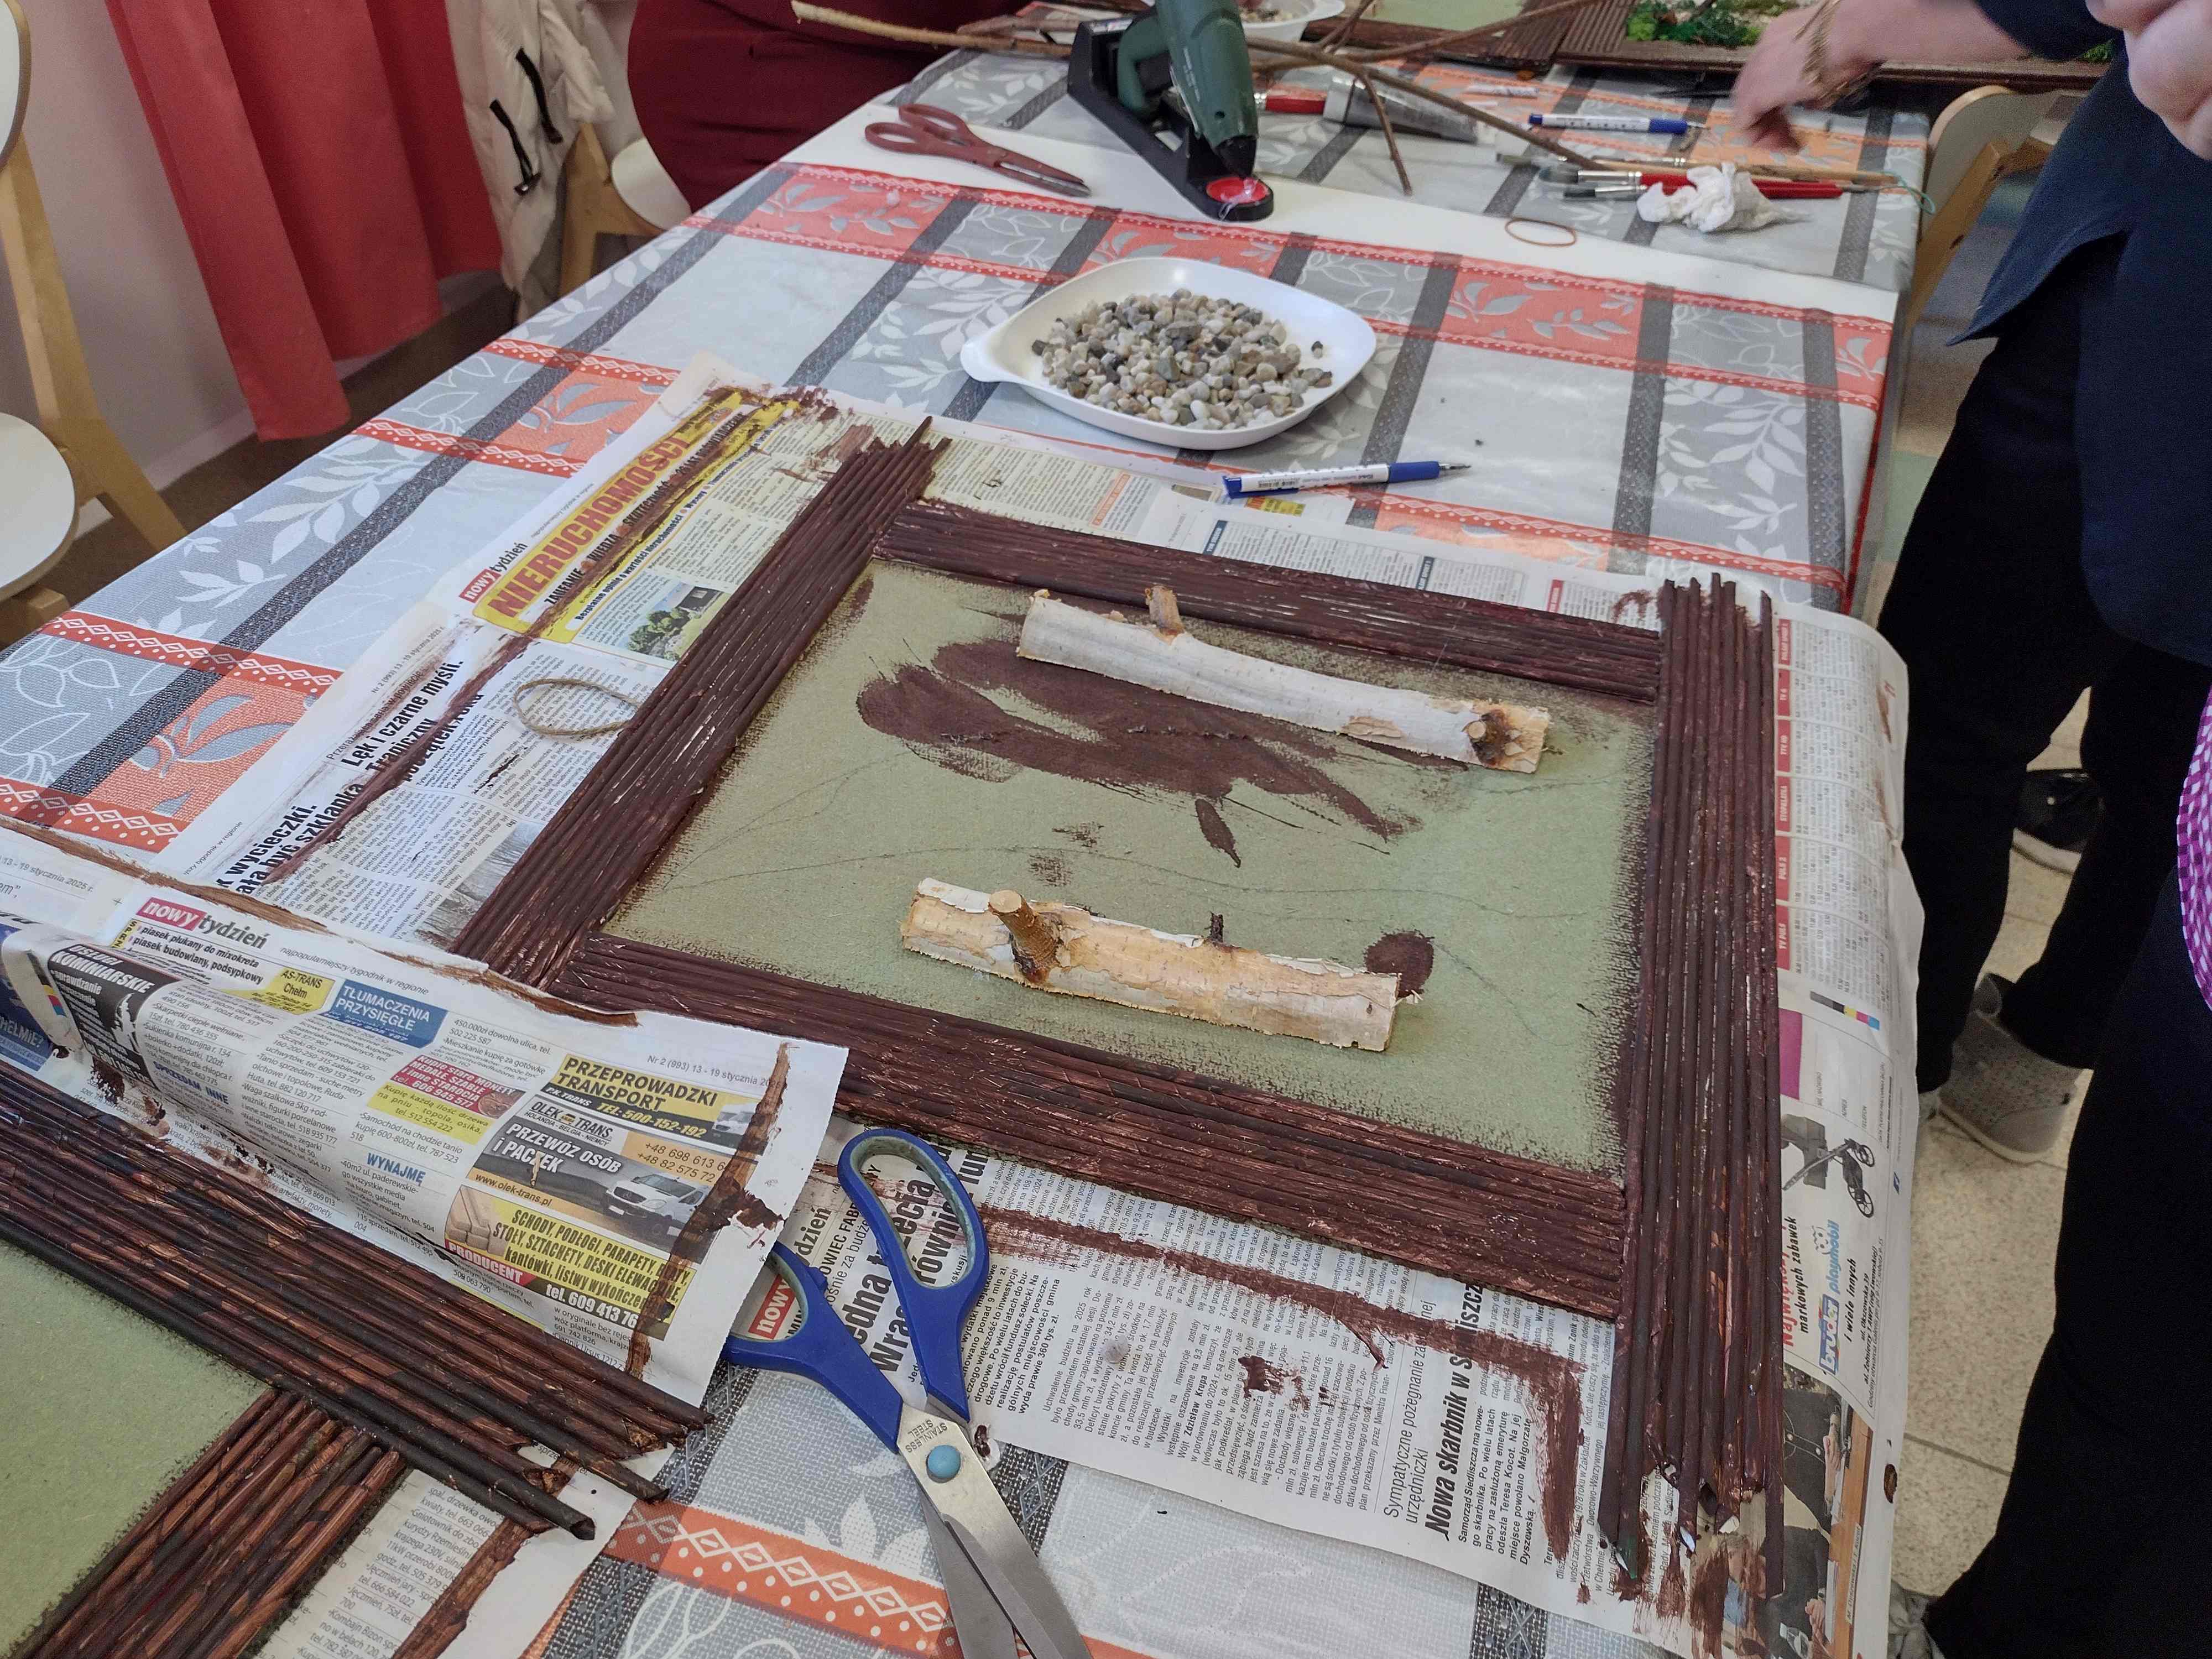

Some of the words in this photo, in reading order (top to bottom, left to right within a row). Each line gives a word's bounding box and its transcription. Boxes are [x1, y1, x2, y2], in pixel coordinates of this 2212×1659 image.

[488, 435, 692, 618] NIERUCHOMOŚCI
[465, 575, 497, 601] nowy
[491, 542, 528, 574] tydzień
[544, 568, 587, 604] ZAUFANIE
[586, 534, 622, 562] WIEDZA
[575, 592, 607, 620] Bezpłatne
[602, 575, 622, 593] opinie
[623, 551, 649, 575] wartości
[645, 514, 685, 551] nieruchomości
[340, 743, 374, 768] Lęk
[368, 735, 387, 744] i
[379, 695, 429, 738] czarne
[420, 660, 464, 696] myśli.
[226, 804, 317, 875] wycieczki.
[260, 842, 301, 870] być
[297, 782, 365, 843] szklanka
[3, 857, 13, 865] 13
[19, 862, 29, 870] 19
[29, 866, 65, 883] stycznia
[65, 877, 87, 890] 2025
[145, 899, 201, 928] nowy
[200, 914, 269, 951] tydzień
[133, 935, 163, 953] piasek
[162, 944, 212, 969] budowlany,
[210, 959, 264, 987] podsypkowy
[140, 925, 171, 943] piasek
[170, 934, 204, 953] płukany
[204, 945, 216, 955] do
[215, 948, 259, 969] mixokreta
[51, 953, 155, 993] KOMINIARSKIE
[280, 967, 323, 990] AS-TRANS
[283, 982, 309, 999] Chełm
[349, 964, 387, 985] tygodnik
[394, 978, 430, 998] regionie
[335, 997, 416, 1032] PRZYSIĘGŁE
[341, 985, 431, 1024] TŁUMACZENIA
[406, 1067, 432, 1083] inne
[429, 1076, 482, 1103] STAROCIA
[409, 1060, 449, 1081] MEDALE
[448, 1074, 487, 1095] SZABLE
[473, 1075, 516, 1097] MONETY
[564, 1055, 718, 1109] PRZEPROWADZKI
[647, 1053, 659, 1064] Nr
[659, 1057, 666, 1066] 2
[666, 1058, 691, 1072] (993)
[691, 1064, 702, 1074] 13
[709, 1068, 720, 1078] 19
[720, 1068, 758, 1088] stycznia
[383, 1084, 409, 1099] Kupię
[408, 1093, 435, 1109] każdą
[436, 1103, 458, 1116] ilość
[458, 1112, 489, 1127] drzewa
[393, 1073, 410, 1084] tel.
[411, 1079, 434, 1094] 606
[433, 1087, 455, 1102] 945
[453, 1095, 474, 1109] 577
[556, 1072, 666, 1114] TRANSPORT
[395, 1108, 408, 1117] tel.
[408, 1112, 421, 1121] 512
[421, 1116, 436, 1126] 554
[435, 1121, 453, 1133] 222
[524, 1110, 556, 1126] HOLANDIA
[557, 1123, 582, 1136] BELGIA
[583, 1134, 610, 1147] NIEMCY
[530, 1099, 563, 1119] OLEK
[574, 1117, 612, 1139] TRANS
[620, 1108, 707, 1140] 500-152-192
[492, 1136, 504, 1153] i
[500, 1140, 565, 1175] PACZEK
[504, 1121, 582, 1159] PRZEWÓZ
[578, 1147, 623, 1175] OSÓB
[635, 1150, 658, 1165] +48
[657, 1156, 675, 1171] 82
[675, 1162, 699, 1178] 575
[644, 1140, 666, 1155] +48
[666, 1146, 690, 1162] 698
[691, 1154, 717, 1170] 613
[364, 1152, 427, 1186] WYNAJMĘ
[473, 1172, 554, 1208] www.olek-trans.pl
[491, 1220, 526, 1248] STOŁY,
[523, 1232, 587, 1268] SZTACHETY,
[582, 1254, 616, 1278] DESKI
[510, 1208, 557, 1237] SCHODY,
[552, 1222, 604, 1255] PODŁOGI,
[599, 1240, 659, 1277] PARAPETY,
[1785, 1217, 1801, 1264] zabawek
[1828, 1219, 1840, 1294] playmobil
[448, 1243, 523, 1283] PRODUCENT
[544, 1281, 570, 1302] tel.
[567, 1291, 598, 1313] 609
[596, 1301, 622, 1322] 413
[502, 1246, 557, 1281] kantówki,
[553, 1264, 591, 1292] listwy
[1848, 1258, 1858, 1297] innych
[1050, 1313, 1060, 1324] zł.
[1793, 1267, 1809, 1334] markowych
[1846, 1300, 1855, 1332] wiele
[973, 1360, 995, 1402] drogowe.
[989, 1348, 999, 1360] Po
[994, 1323, 1009, 1347] wielu
[1003, 1297, 1019, 1323] latach
[1013, 1285, 1023, 1297] do
[1018, 1270, 1029, 1284] bu-
[1037, 1342, 1049, 1358] 360
[1042, 1324, 1057, 1342] tys.
[1822, 1299, 1839, 1368] bruder
[1026, 1359, 1045, 1389] prawie
[1449, 1373, 1468, 1389] w
[1018, 1390, 1034, 1415] wyda
[1183, 1400, 1200, 1437] Zdzisław
[1194, 1374, 1209, 1397] Krupa
[1475, 1406, 1485, 1432] nowe-
[906, 1422, 948, 1453] STAINLESS
[907, 1419, 934, 1436] STEEL
[1384, 1430, 1412, 1518] Sympatyczne
[1406, 1359, 1423, 1427] pożegnanie
[1443, 1390, 1469, 1475] skarbnik
[1473, 1433, 1482, 1446] ma
[1406, 1449, 1428, 1523] urzędniczki
[1465, 1447, 1480, 1495] Siedliszcza
[1424, 1478, 1456, 1535] Nowa
[1458, 1497, 1474, 1543] Samorząd
[358, 1573, 372, 1586] tel.
[369, 1579, 386, 1593] 666
[383, 1585, 401, 1601] 584
[398, 1593, 415, 1609] 022
